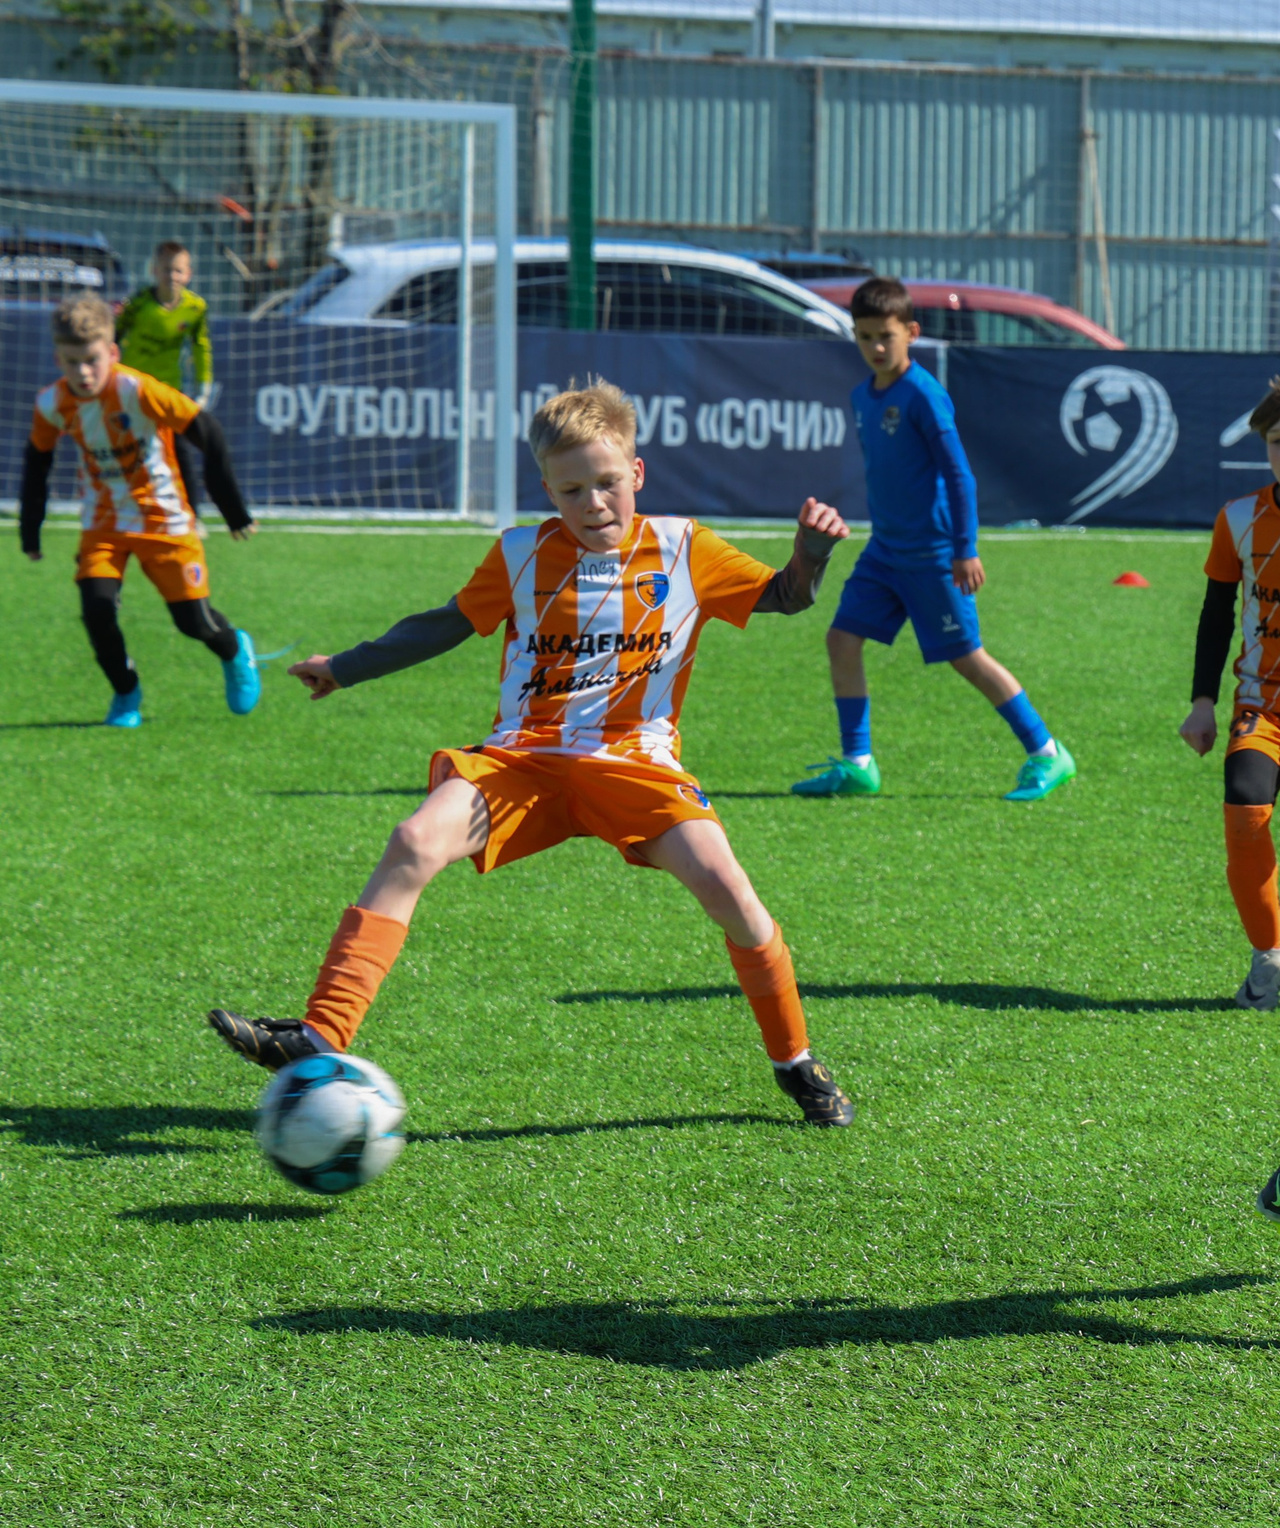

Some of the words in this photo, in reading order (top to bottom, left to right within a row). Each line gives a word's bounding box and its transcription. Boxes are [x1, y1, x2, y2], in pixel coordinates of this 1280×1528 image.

[256, 382, 558, 441] ФУТБОЛЬНЫ
[628, 395, 688, 446] УБ
[695, 397, 846, 450] «СОЧИ»
[526, 631, 672, 658] АКАДЕМИЯ
